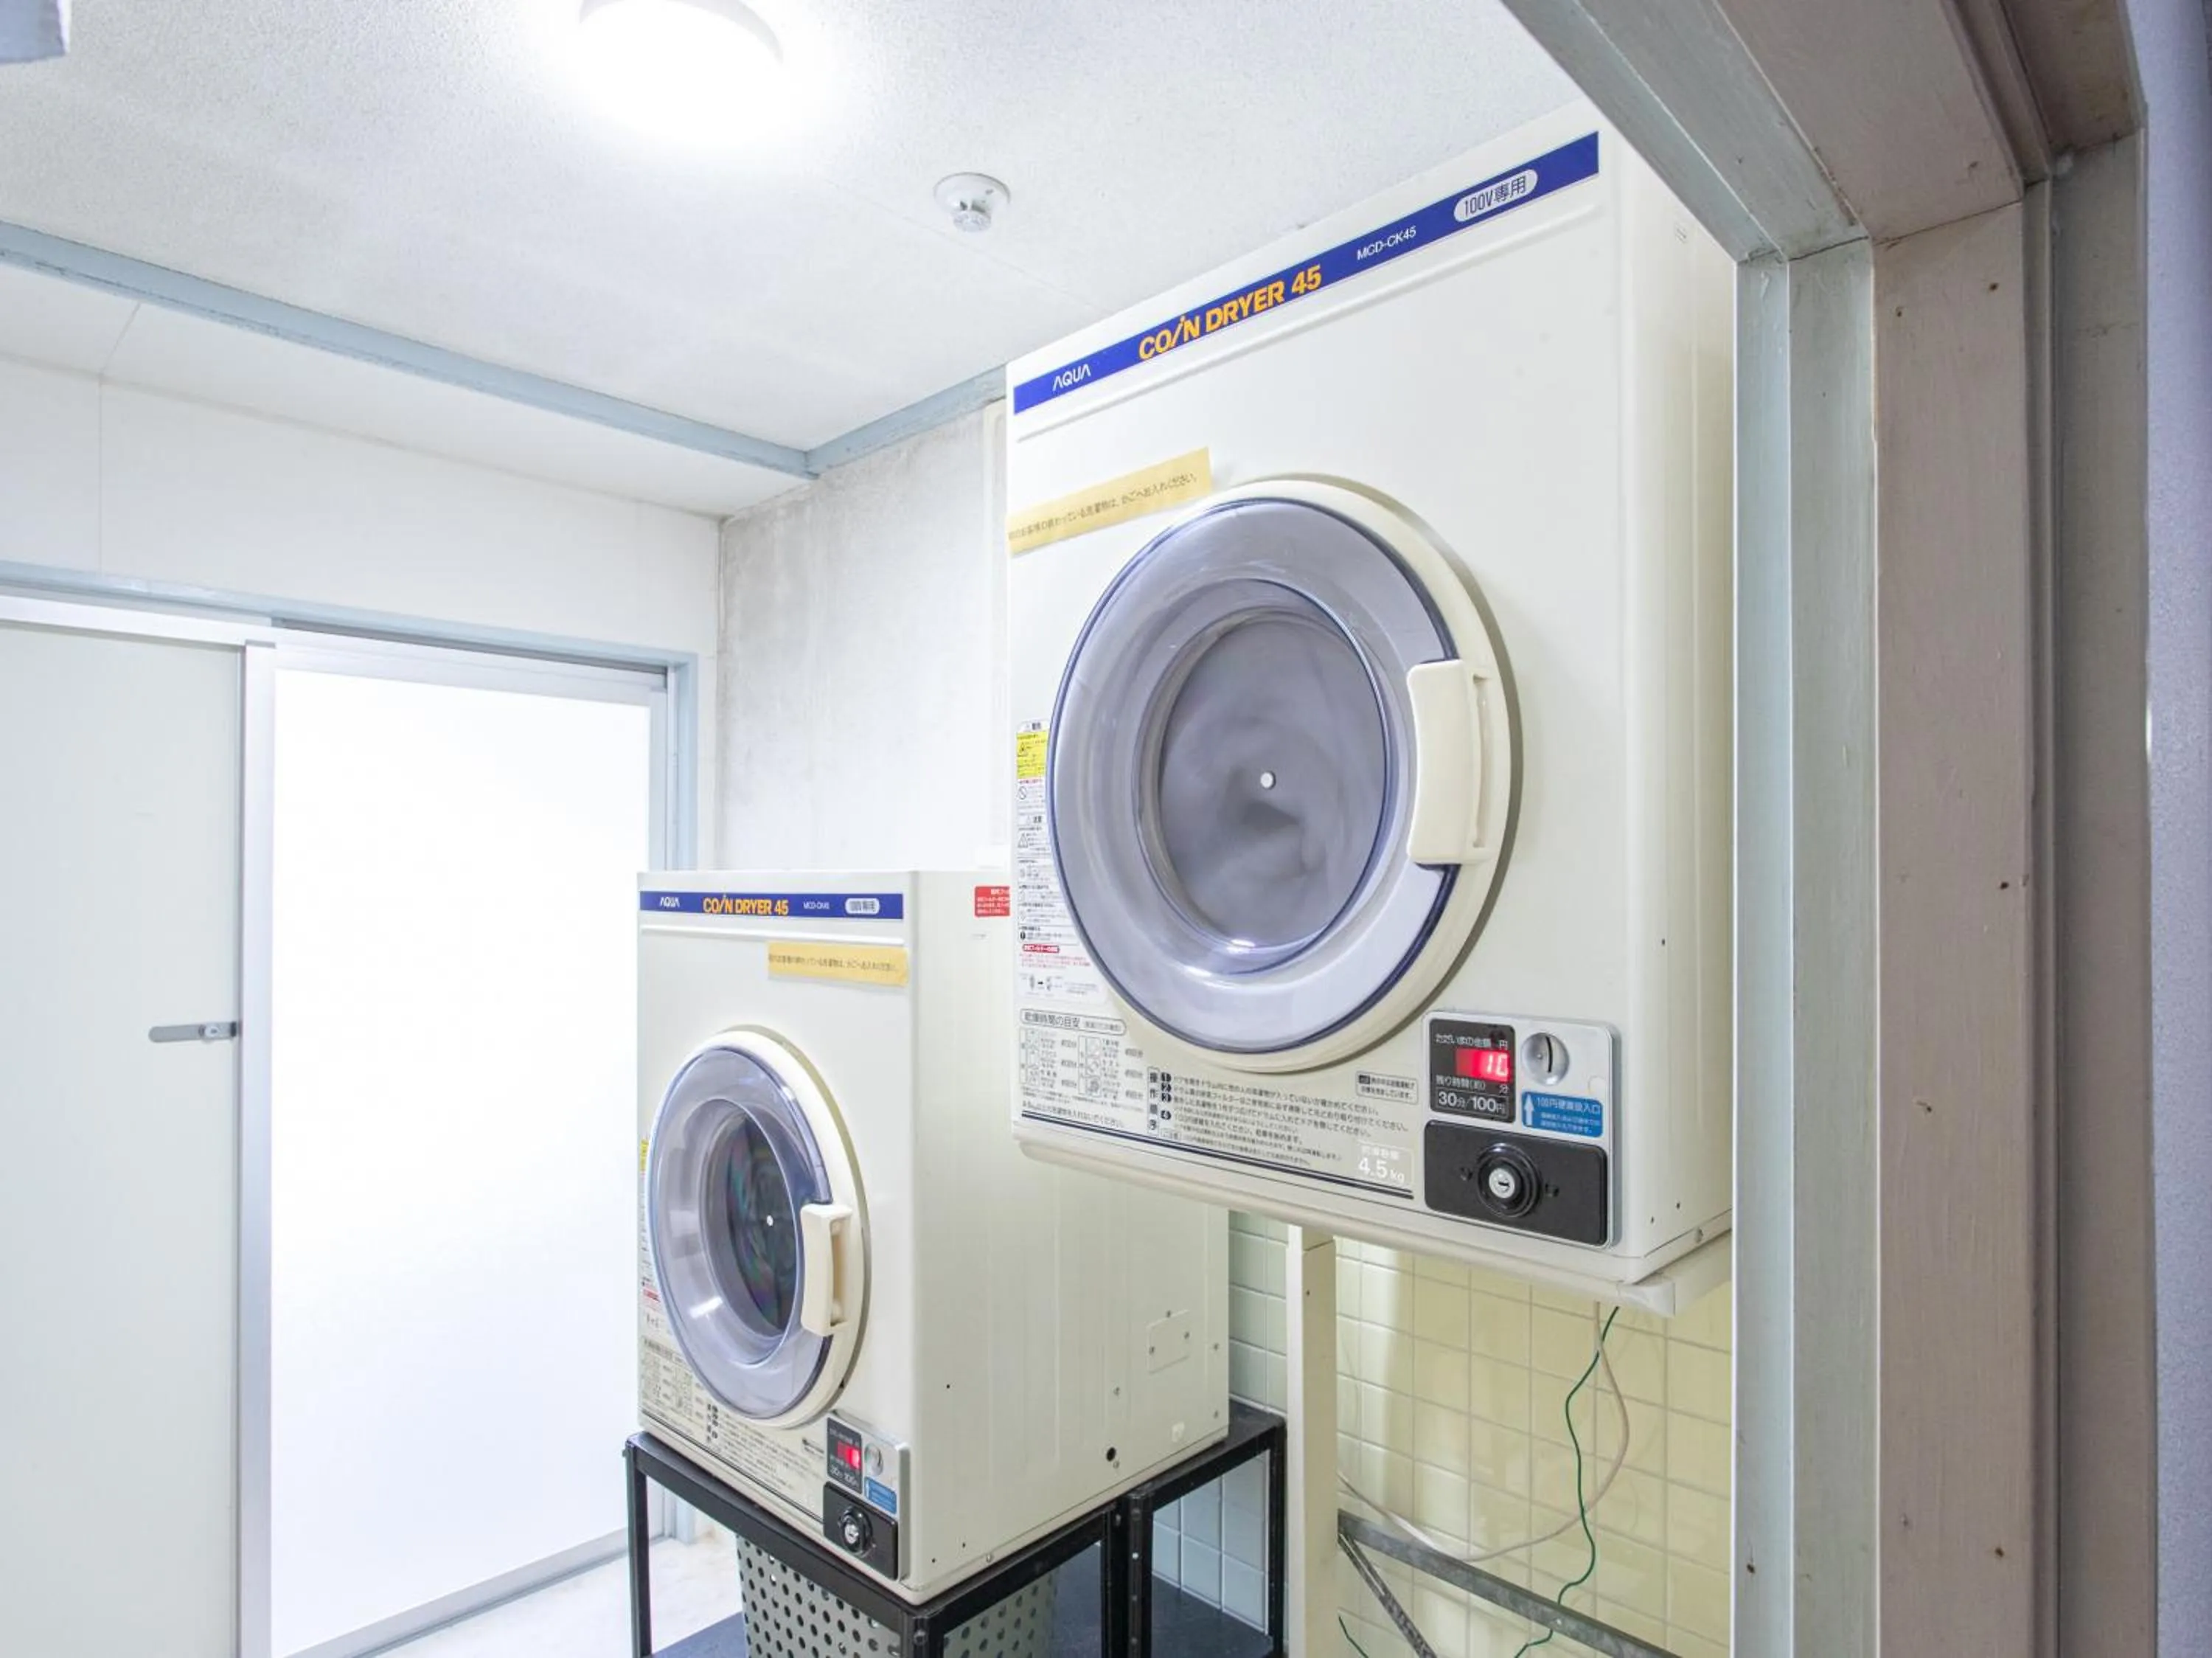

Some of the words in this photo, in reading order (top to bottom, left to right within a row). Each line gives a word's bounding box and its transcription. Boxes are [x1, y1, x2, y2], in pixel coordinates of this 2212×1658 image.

[1463, 176, 1527, 218] 100V専用
[1052, 364, 1091, 392] AQUA
[1205, 281, 1285, 334] DRYER
[1291, 264, 1322, 296] 45
[1357, 226, 1416, 261] MCD-CK45
[737, 899, 772, 915] DRYER
[774, 900, 788, 916] 45
